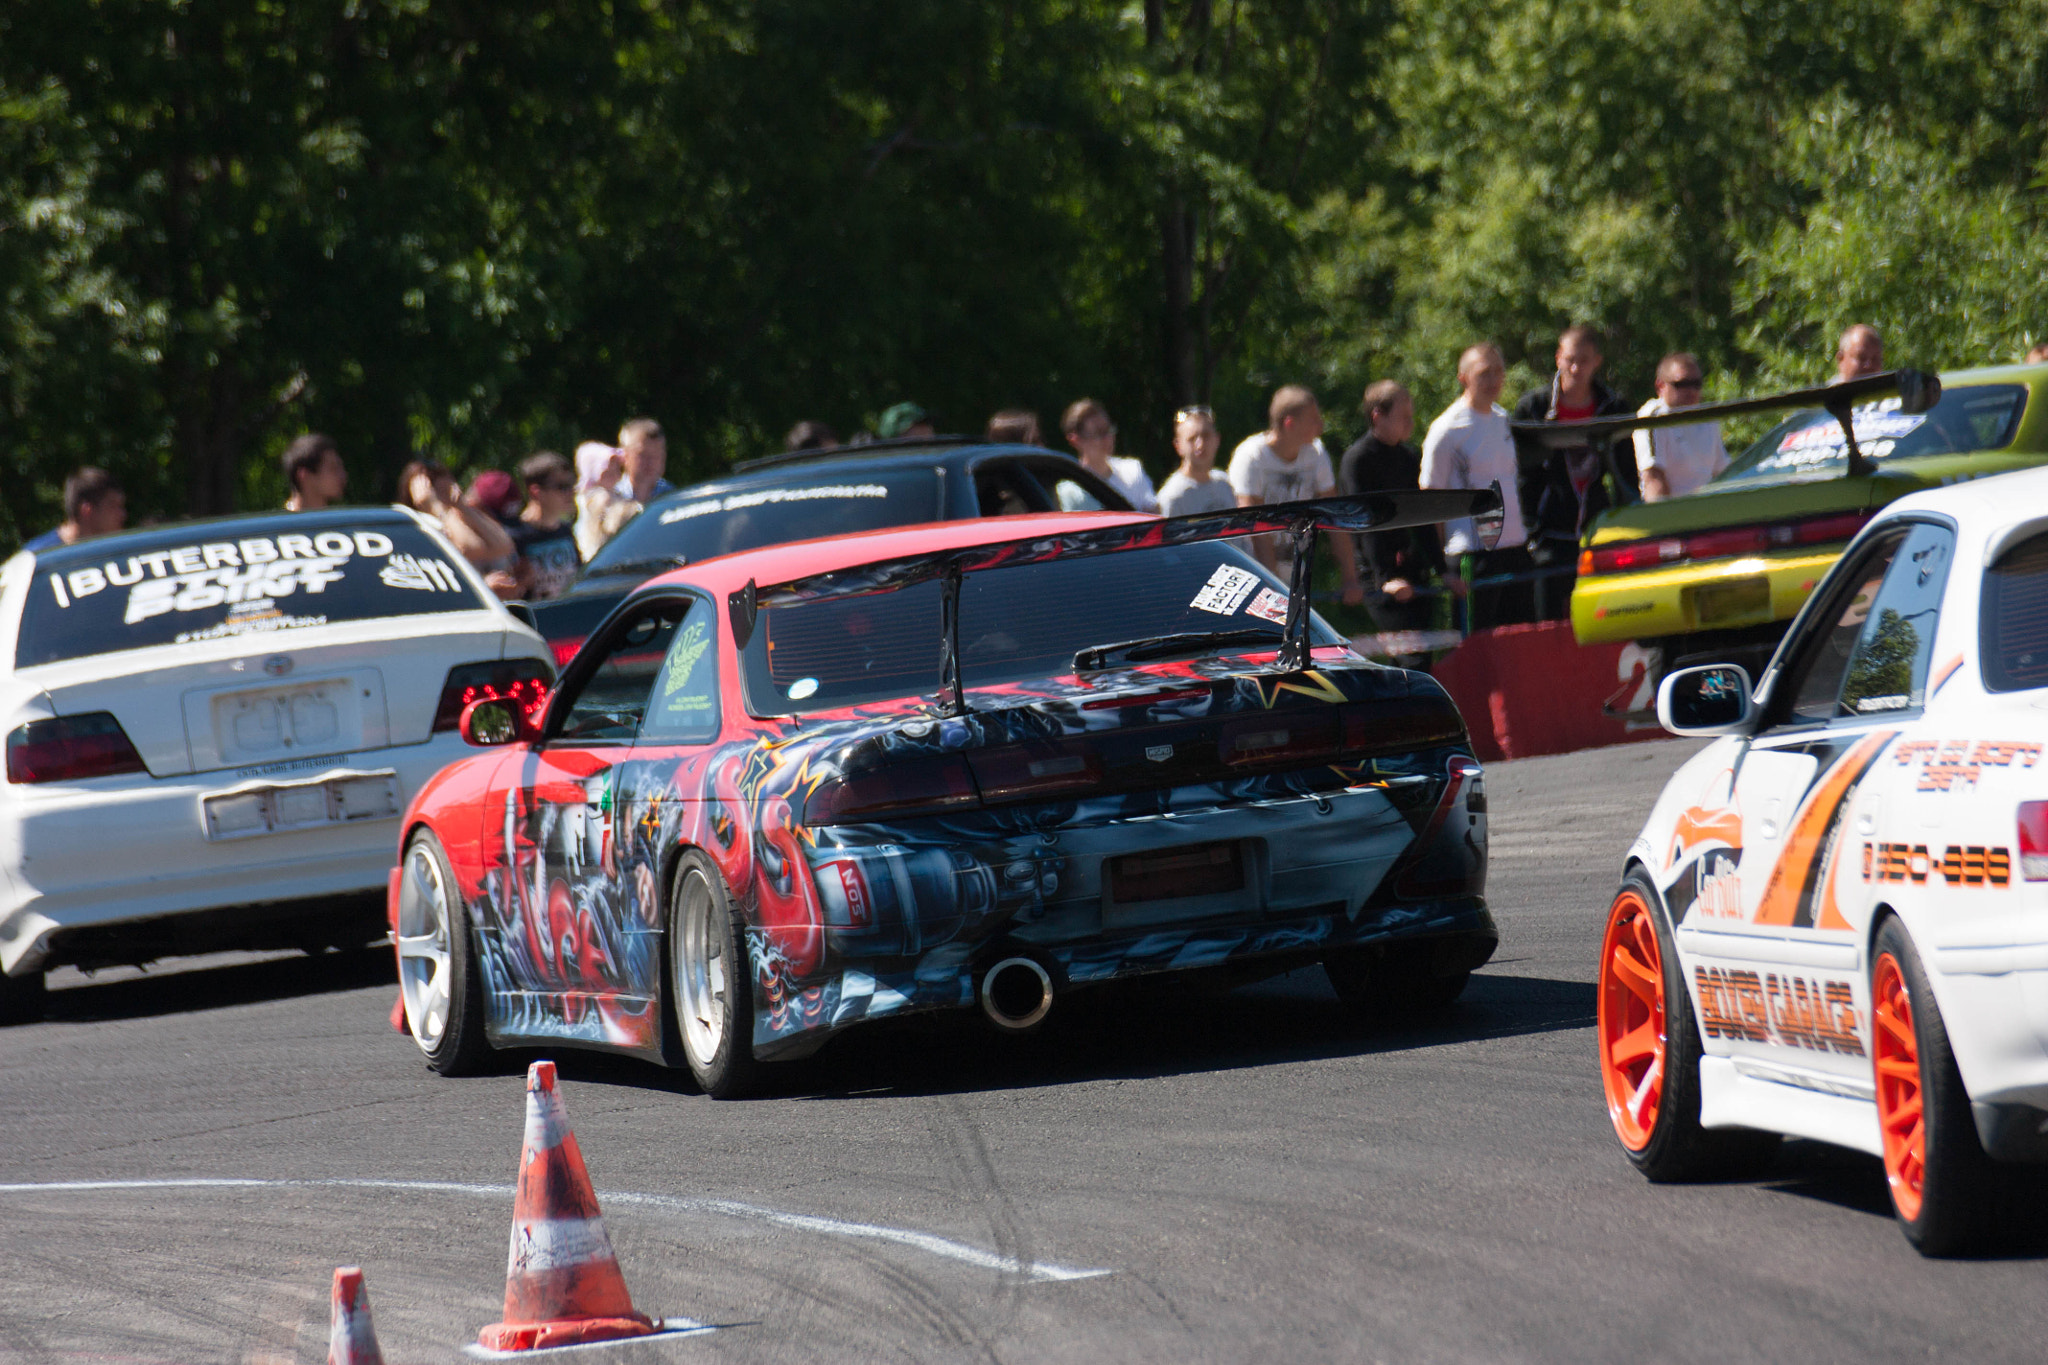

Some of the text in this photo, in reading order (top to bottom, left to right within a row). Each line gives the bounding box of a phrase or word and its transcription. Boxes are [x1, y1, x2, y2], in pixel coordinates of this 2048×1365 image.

[68, 531, 394, 599] BUTERBROD
[1206, 570, 1245, 609] FACTORY
[123, 571, 347, 625] POINT
[841, 867, 864, 918] NOS
